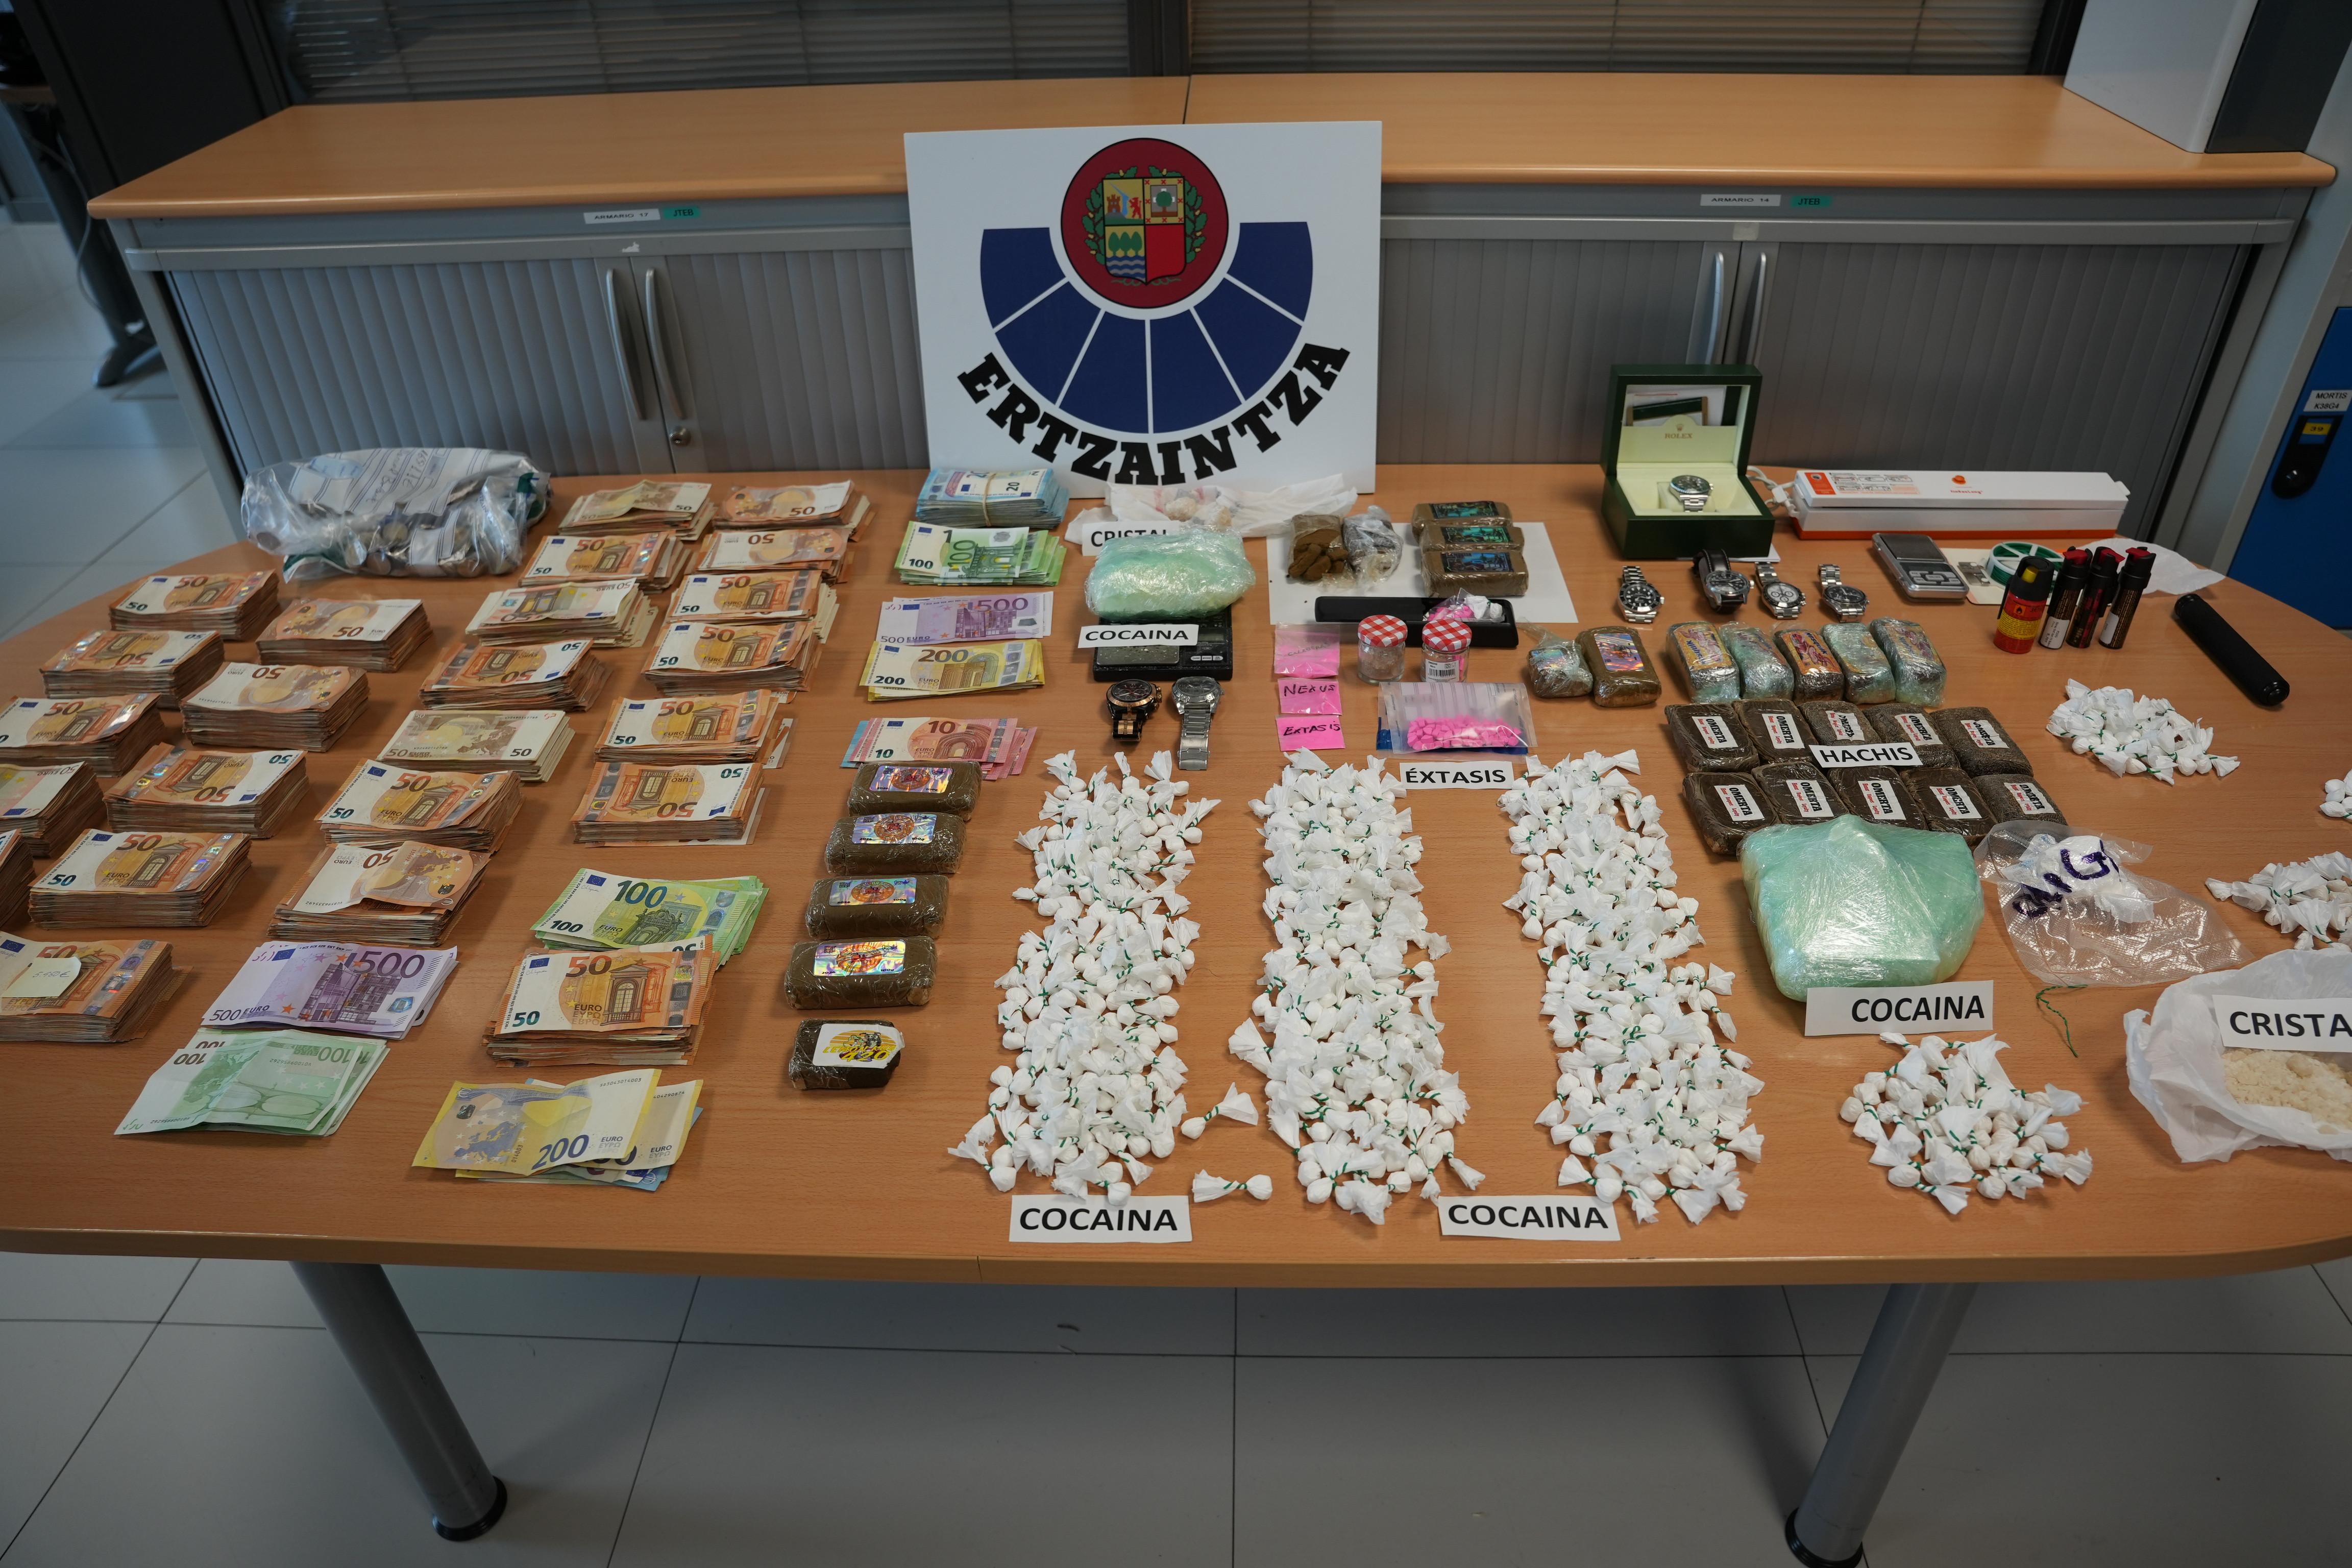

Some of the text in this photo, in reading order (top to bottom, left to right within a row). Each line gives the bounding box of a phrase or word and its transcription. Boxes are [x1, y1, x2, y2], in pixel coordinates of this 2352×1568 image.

[673, 209, 694, 217] JTEB
[957, 342, 1350, 485] ERTZAINTZA
[1006, 482, 1020, 492] 20
[789, 506, 816, 517] 50
[575, 540, 605, 552] 50
[748, 534, 775, 545] 50
[909, 558, 934, 570] 100
[174, 576, 208, 589] 50
[616, 581, 632, 590] 50
[718, 576, 752, 590] 50
[125, 601, 148, 611] 50
[680, 605, 700, 613] 50
[977, 598, 1029, 612] 500
[333, 627, 364, 638] 50
[700, 626, 736, 643] 50
[1085, 630, 1188, 641] COCAINA
[561, 642, 582, 651] 50
[1805, 632, 1828, 655] Nesquik
[116, 652, 153, 666] 50
[657, 656, 679, 666] 50
[918, 649, 969, 663] 200
[251, 667, 286, 679] 50
[501, 670, 537, 683] 50
[873, 675, 905, 685] 200
[1284, 684, 1336, 697] NEXUS
[44, 701, 84, 716] 50
[658, 701, 694, 716] 50
[927, 721, 956, 734] 10
[1706, 718, 1727, 744] OMERTA
[1776, 716, 1795, 744] OMERTA
[614, 736, 636, 744] 50
[386, 749, 409, 757] 50
[510, 748, 532, 757] 50
[875, 749, 894, 758] 10
[1819, 747, 1914, 763] HACHIS
[269, 755, 293, 764] 50
[720, 768, 744, 778] 50
[1405, 768, 1506, 783] ÉXTASIS
[390, 773, 432, 792] 50
[194, 787, 236, 802] 50
[1800, 782, 1822, 812] OMERTA
[1871, 782, 1893, 814] OMERTA
[1729, 788, 1753, 816] OMERTA
[1945, 788, 1970, 815] OMERTA
[329, 807, 354, 819] 50
[657, 802, 698, 818] 50
[115, 834, 162, 851] 50
[363, 849, 399, 869] 50
[47, 874, 77, 886] 50
[613, 880, 668, 909] 100
[550, 920, 583, 933] 100
[599, 924, 623, 933] EURO
[359, 950, 426, 979] 500
[565, 955, 612, 977] 50
[209, 1004, 270, 1021] 500 EURO
[574, 1003, 602, 1012] EURO
[1851, 995, 1985, 1022] COCAINA
[512, 1011, 540, 1027] 50
[173, 1054, 205, 1065] 100
[317, 1045, 350, 1064] 100
[841, 1050, 890, 1062] 420
[653, 1090, 685, 1100] 404290874
[511, 1144, 524, 1163] 014003
[531, 1134, 590, 1171] 200
[1020, 1207, 1178, 1231] COCAINA
[1448, 1204, 1609, 1229] COCAINA
